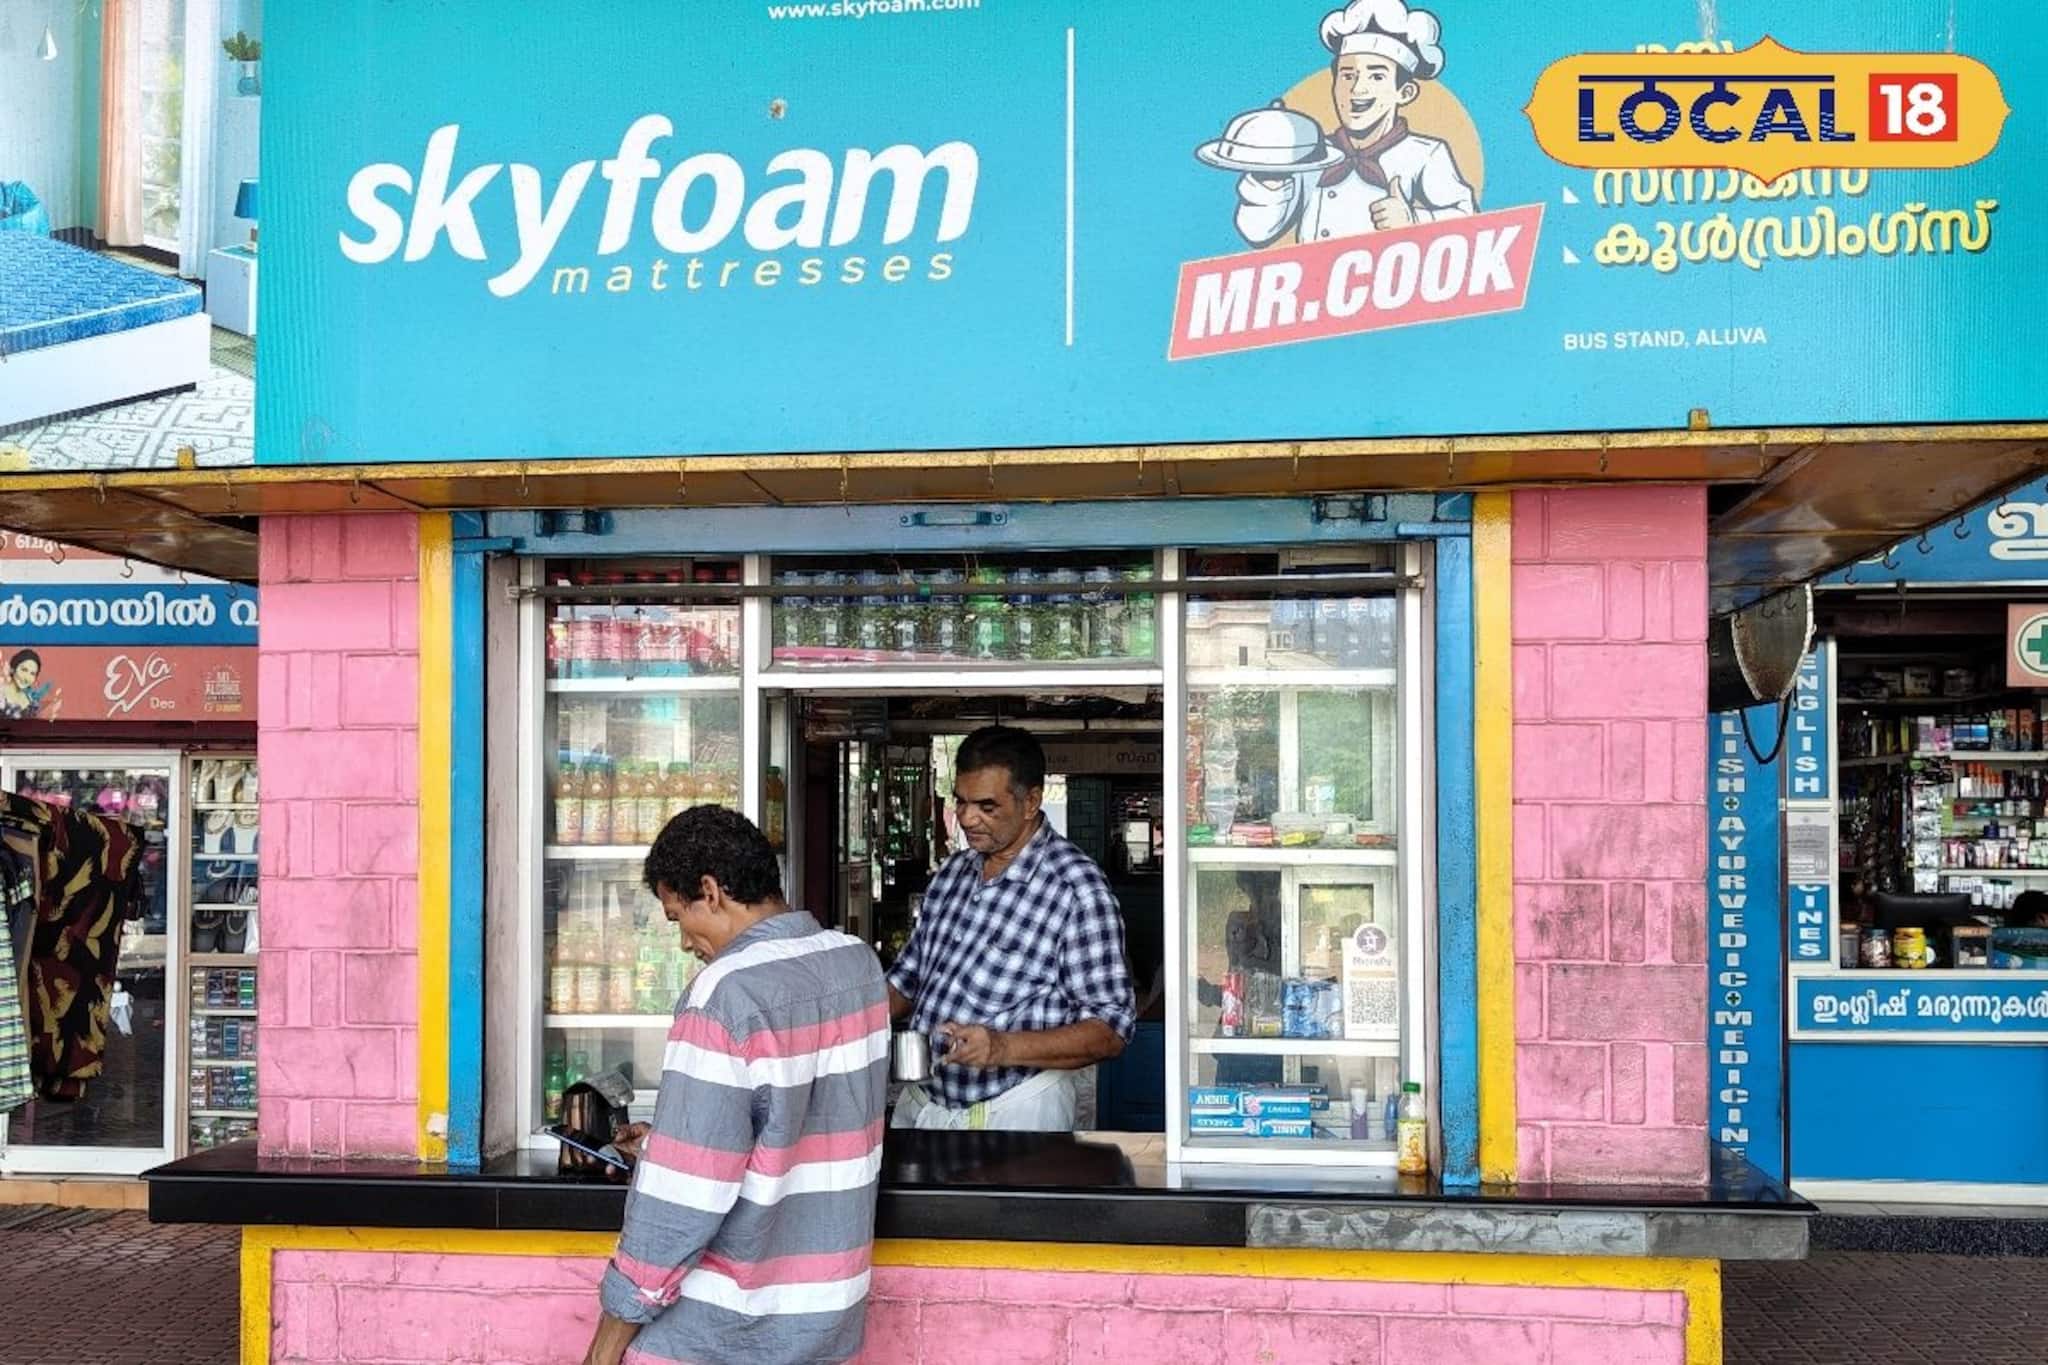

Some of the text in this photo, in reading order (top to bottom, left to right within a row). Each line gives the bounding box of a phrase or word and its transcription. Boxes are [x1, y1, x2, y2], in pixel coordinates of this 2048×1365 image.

[338, 113, 980, 298] skyfoam
[551, 250, 954, 294] mattresses
[1187, 222, 1525, 341] MR.COOK
[1563, 327, 1767, 350] BUS STAND, ALUVA
[1717, 709, 1746, 793] LISH
[1794, 653, 1820, 793] ENGLISH
[1717, 816, 1748, 988] AYURVEDIC
